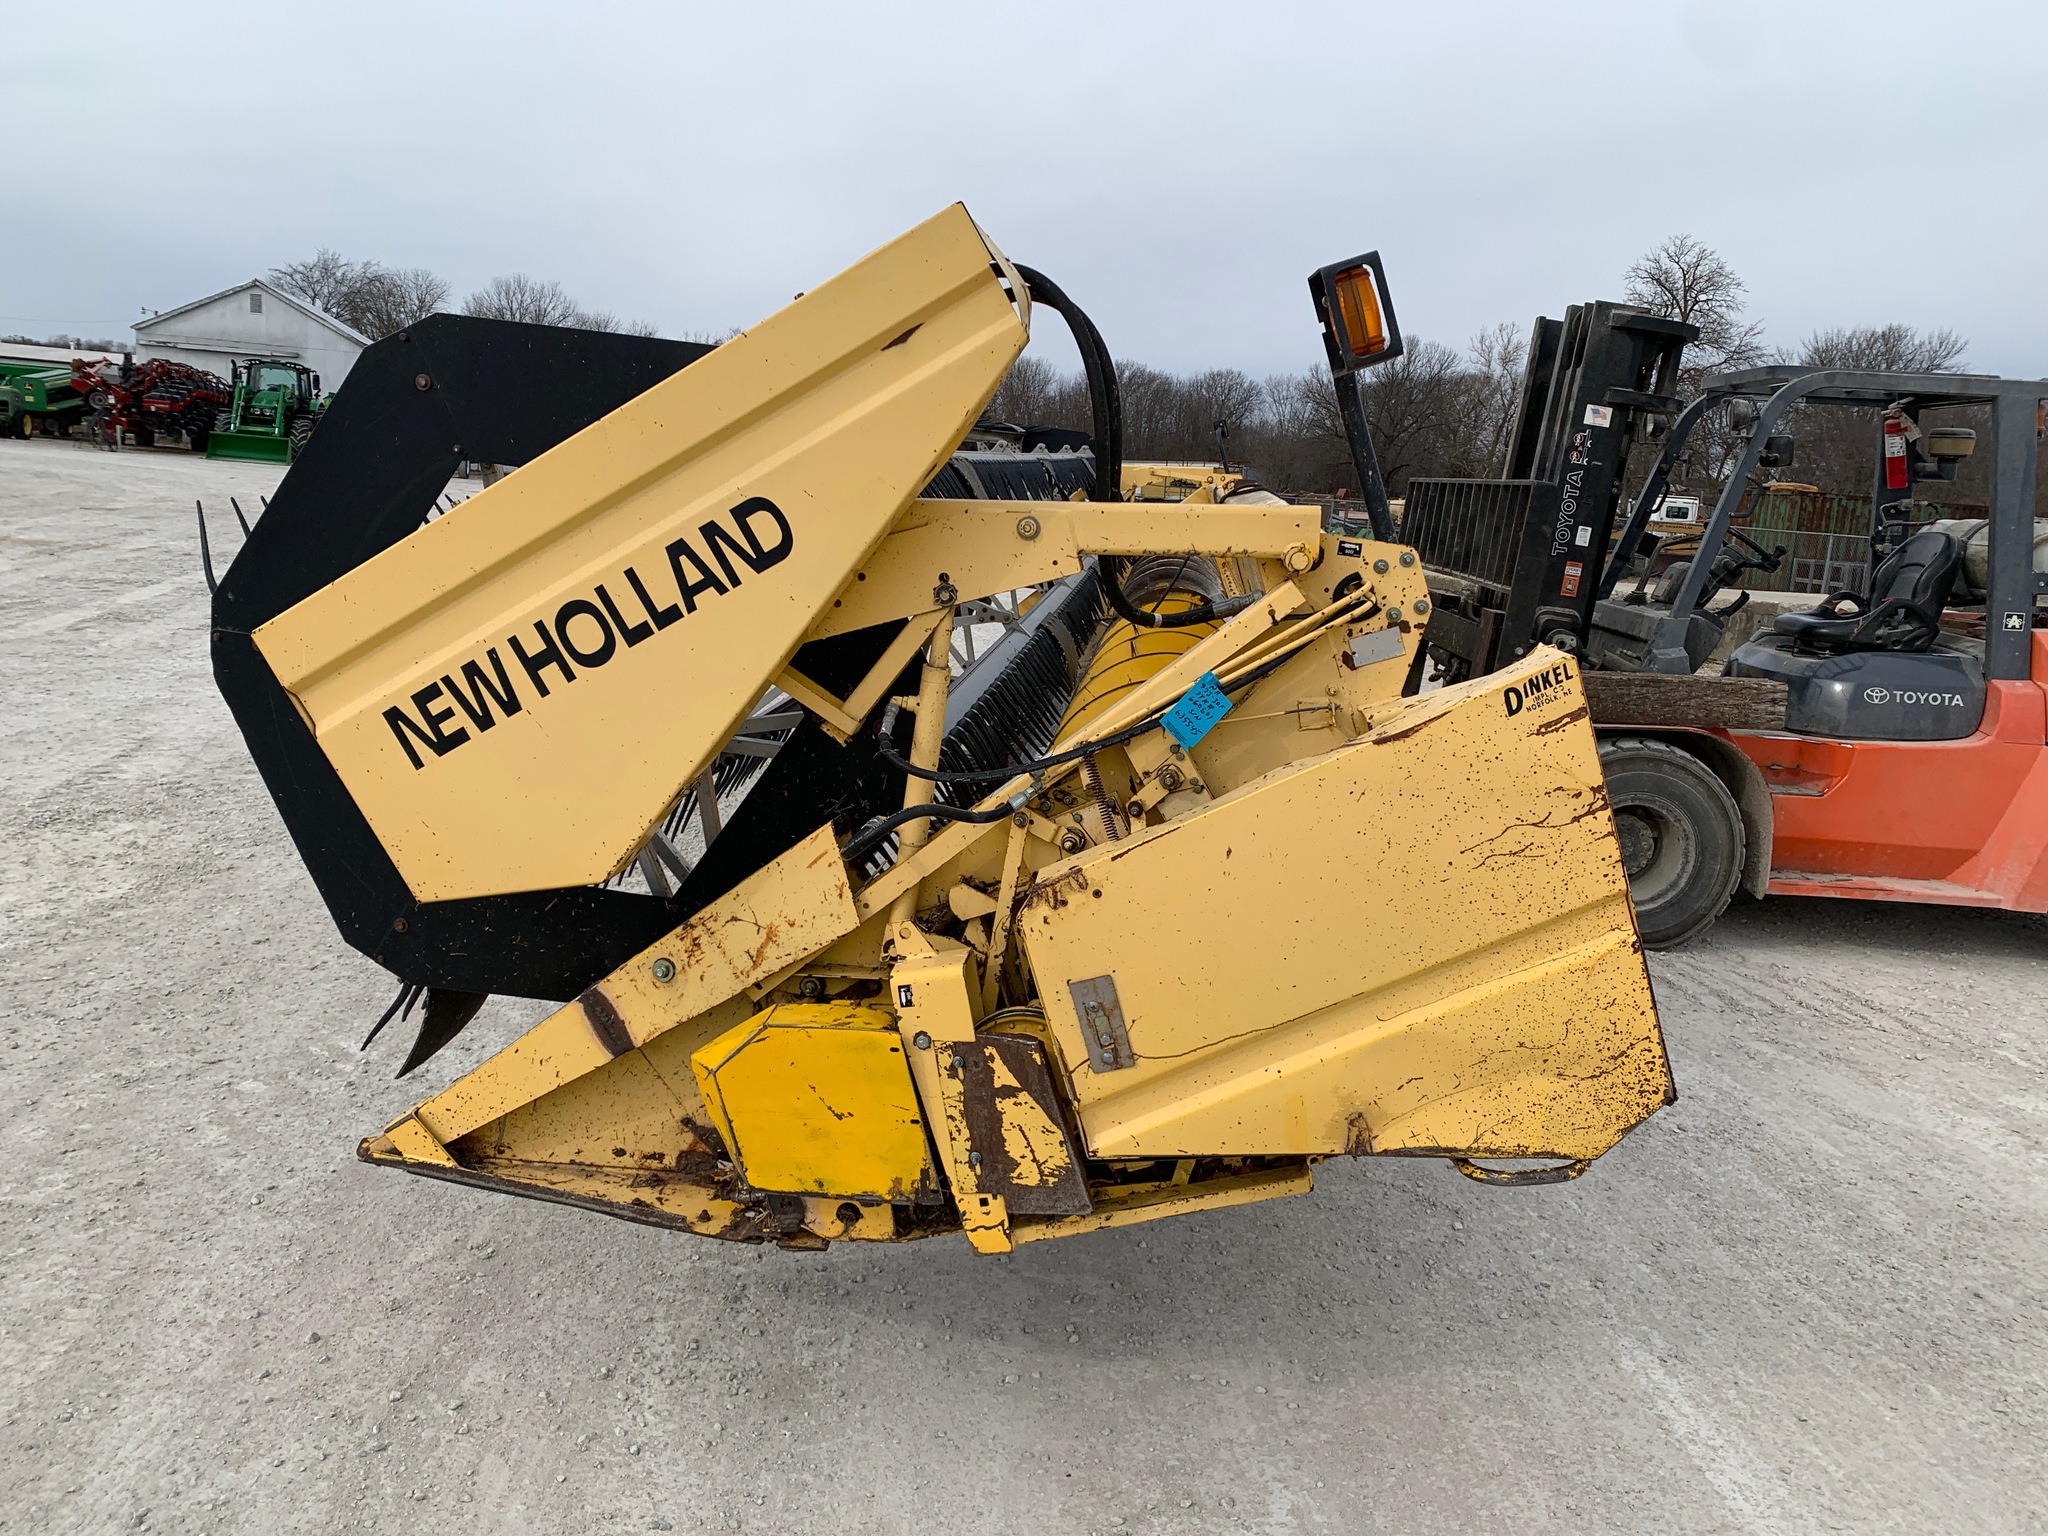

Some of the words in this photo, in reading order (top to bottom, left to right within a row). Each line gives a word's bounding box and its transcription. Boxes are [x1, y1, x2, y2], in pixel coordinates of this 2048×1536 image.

[1551, 470, 1583, 556] TOYOTA
[382, 647, 522, 771] NEW
[507, 496, 794, 698] HOLLAND
[1504, 663, 1573, 717] DINKEL
[1893, 690, 1964, 707] TOYOTA
